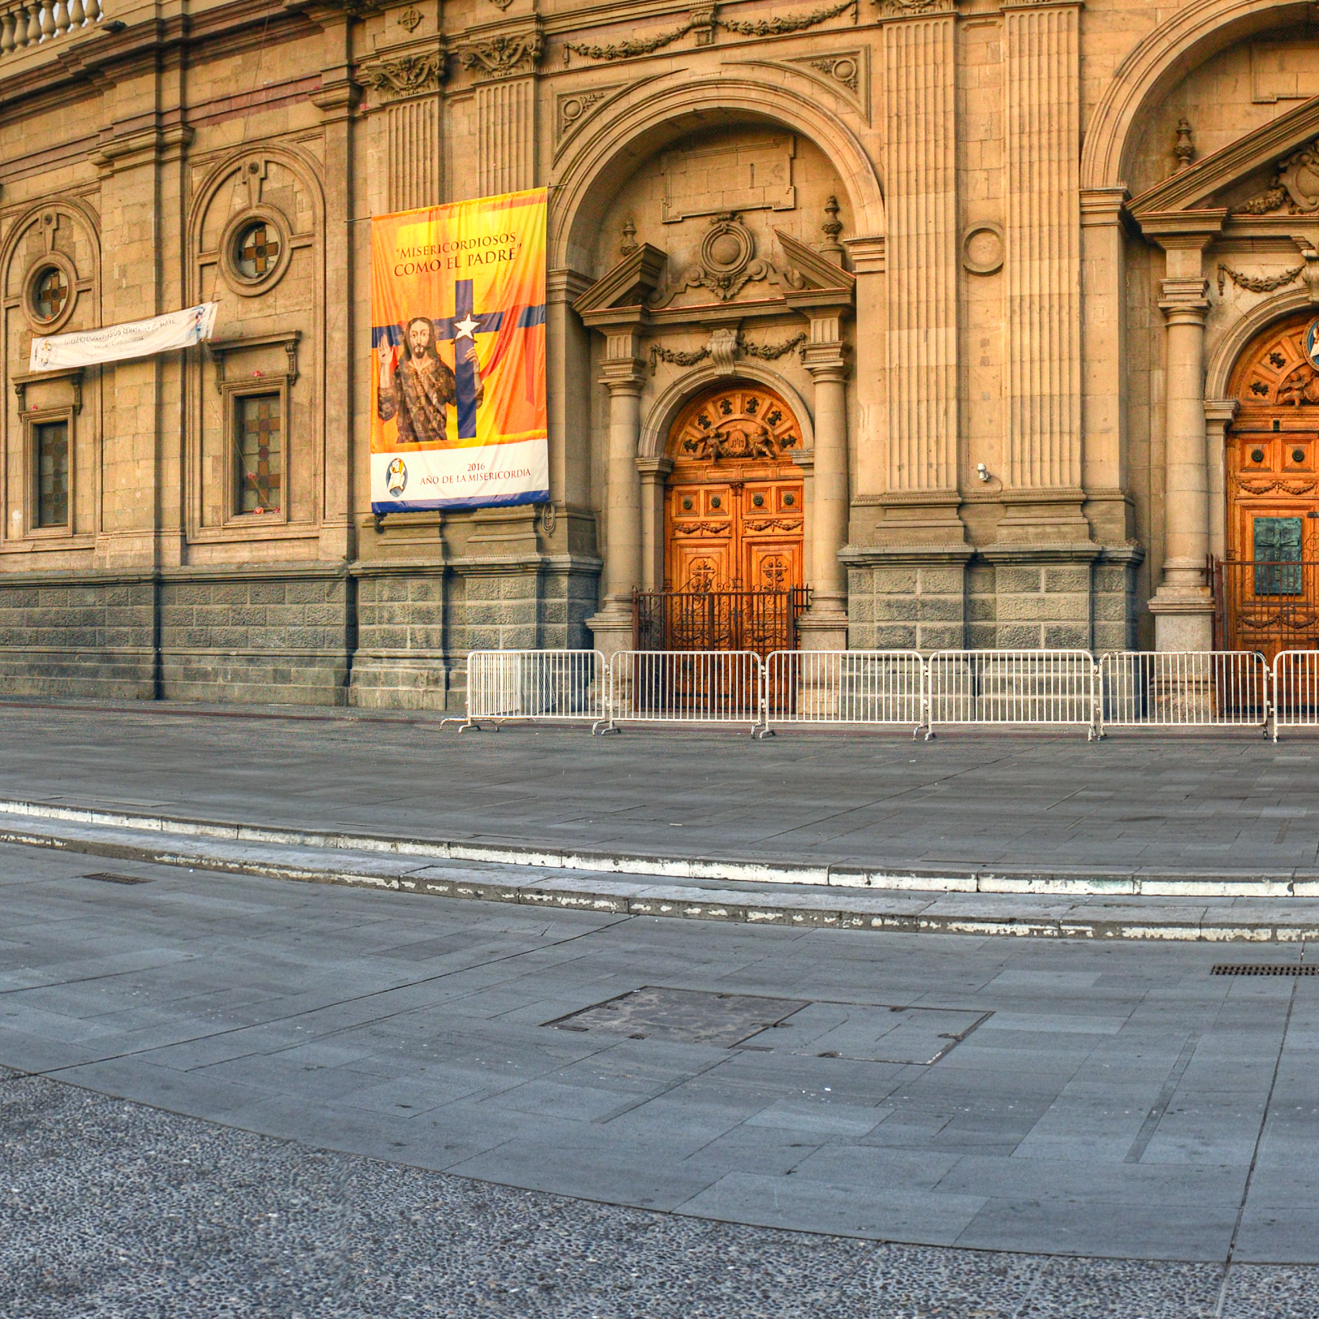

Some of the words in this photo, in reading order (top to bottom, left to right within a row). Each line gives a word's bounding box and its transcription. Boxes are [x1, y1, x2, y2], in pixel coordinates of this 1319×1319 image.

[394, 259, 441, 276] COMO
[447, 256, 462, 270] EL
[467, 463, 485, 472] 2016
[420, 474, 439, 485] AÑO
[456, 475, 466, 483] LA
[468, 468, 531, 482] MISERICORDIA
